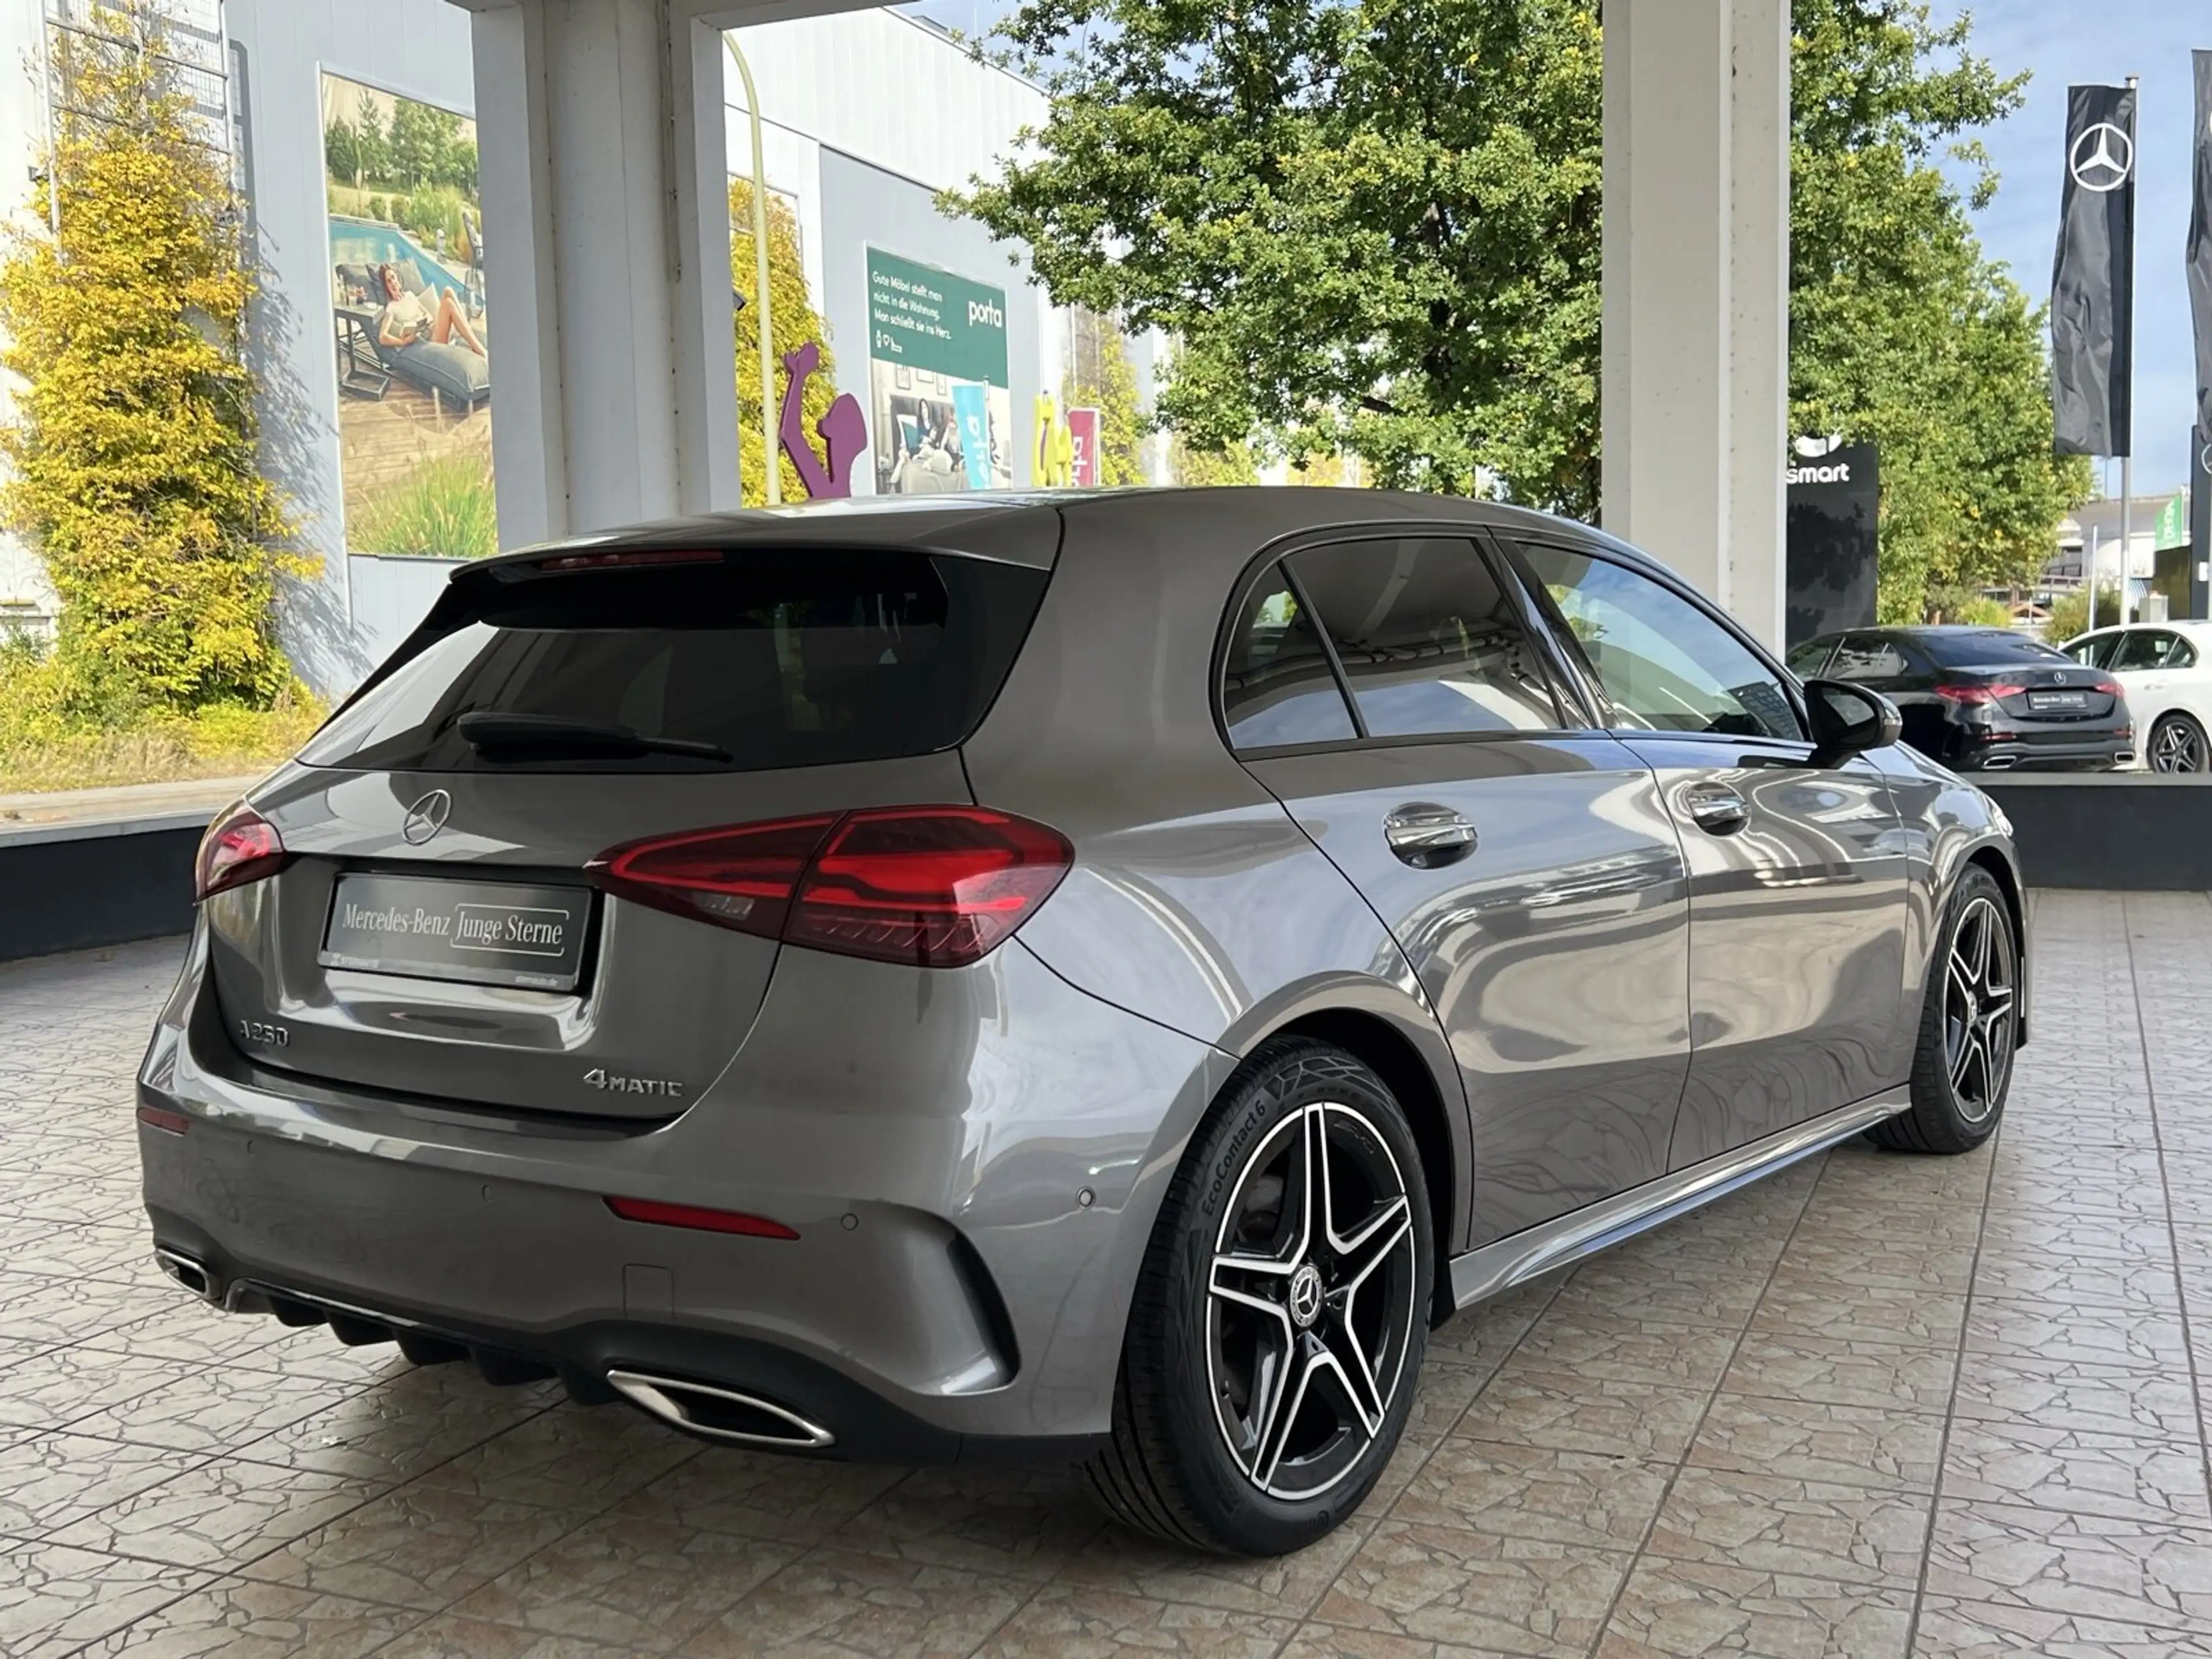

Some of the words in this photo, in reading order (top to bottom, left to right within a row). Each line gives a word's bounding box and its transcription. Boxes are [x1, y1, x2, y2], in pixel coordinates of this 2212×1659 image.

[872, 271, 889, 287] Gute
[891, 276, 910, 293] Möbel
[927, 290, 942, 302] man
[873, 291, 890, 305] nicht
[891, 294, 898, 306] in
[874, 308, 889, 323] Man
[915, 320, 925, 332] sie
[968, 298, 1002, 328] porta
[1786, 463, 1850, 484] smart
[342, 903, 451, 935] Mercedes-Benz
[455, 911, 502, 945] Junge
[505, 915, 563, 945] Sterne
[583, 1068, 683, 1097] 4MATIC
[1202, 1110, 1260, 1217] EcoContact
[1253, 1099, 1266, 1116] 6
